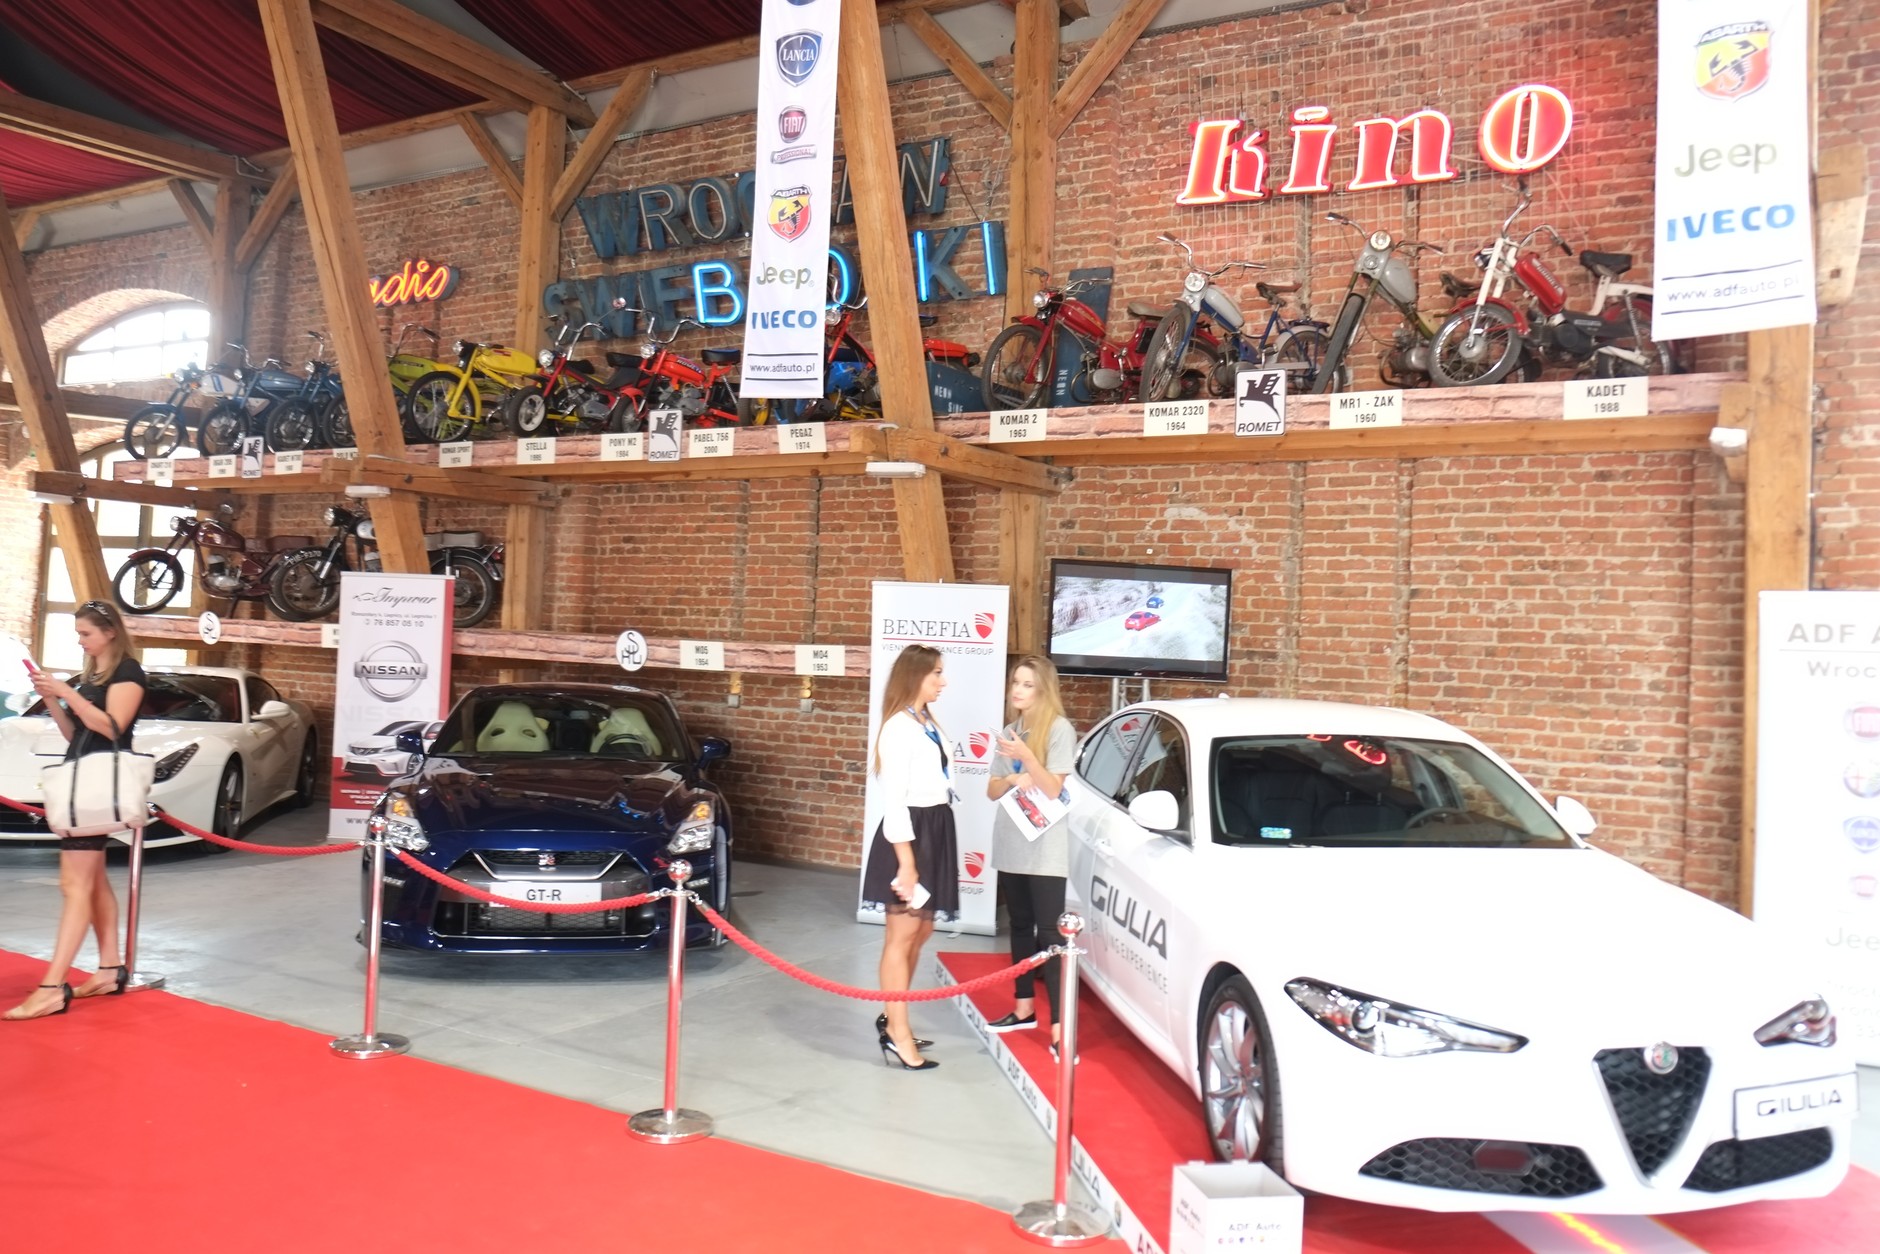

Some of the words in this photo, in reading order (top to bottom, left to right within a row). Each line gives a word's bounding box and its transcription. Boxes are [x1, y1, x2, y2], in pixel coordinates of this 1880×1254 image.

[782, 49, 815, 61] LANCIA
[784, 117, 803, 134] FIAT
[1674, 143, 1777, 178] Jeep
[774, 186, 810, 197] ABARTH
[1667, 204, 1796, 242] IVECO
[756, 262, 812, 290] Jeep
[752, 310, 818, 330] IVECO
[750, 362, 816, 375] www.adfauto.pl
[1587, 384, 1627, 398] KADET
[1339, 397, 1362, 409] MR1
[1594, 402, 1620, 413] 1988
[1149, 407, 1179, 417] KOMAR
[1182, 405, 1205, 416] 2320
[1000, 415, 1030, 425] KOMAR
[1032, 414, 1038, 424] 2
[1355, 413, 1377, 423] 1960
[1166, 421, 1186, 431] 1964
[1237, 421, 1282, 433] ROMET
[790, 428, 813, 438] PEGAZ
[1009, 429, 1028, 438] 1963
[526, 442, 548, 451] STELLA
[609, 438, 628, 447] PONY
[651, 450, 678, 459] ROMET
[882, 618, 972, 638] BENEFIA
[1787, 623, 1856, 644] ADF
[812, 649, 829, 660] M04
[964, 647, 994, 656] GROUP
[360, 665, 421, 676] NISSAN
[960, 766, 989, 775] GROUP
[526, 889, 562, 902] GT-R
[1091, 875, 1168, 960] GIULIA
[1757, 1090, 1842, 1117] GIULIA
